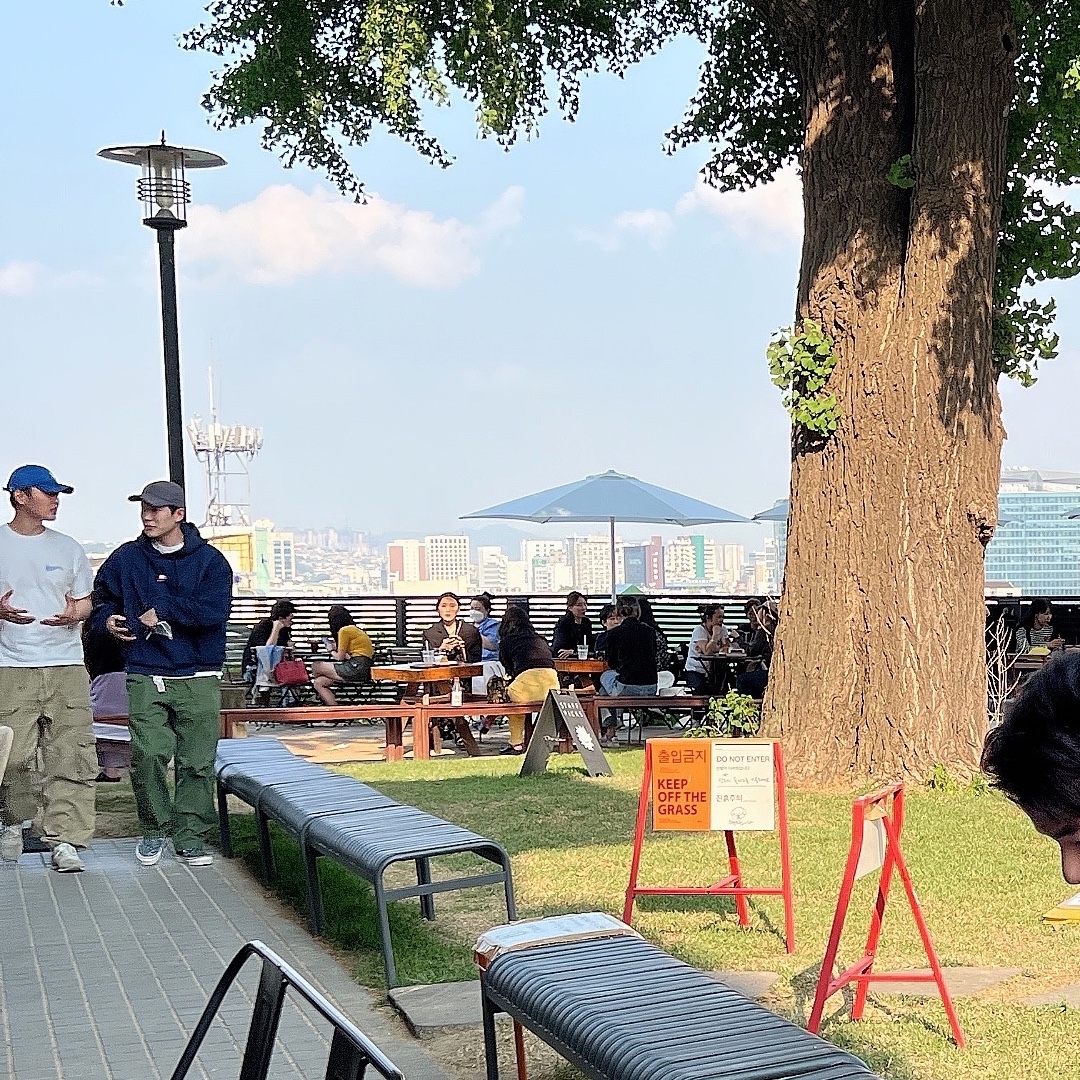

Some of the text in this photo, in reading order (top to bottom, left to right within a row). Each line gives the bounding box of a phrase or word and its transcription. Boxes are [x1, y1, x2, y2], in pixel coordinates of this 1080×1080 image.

[658, 749, 706, 763] 출입금지
[657, 779, 688, 789] KEEP
[658, 792, 706, 802] OFF THE
[658, 804, 697, 815] GRASS
